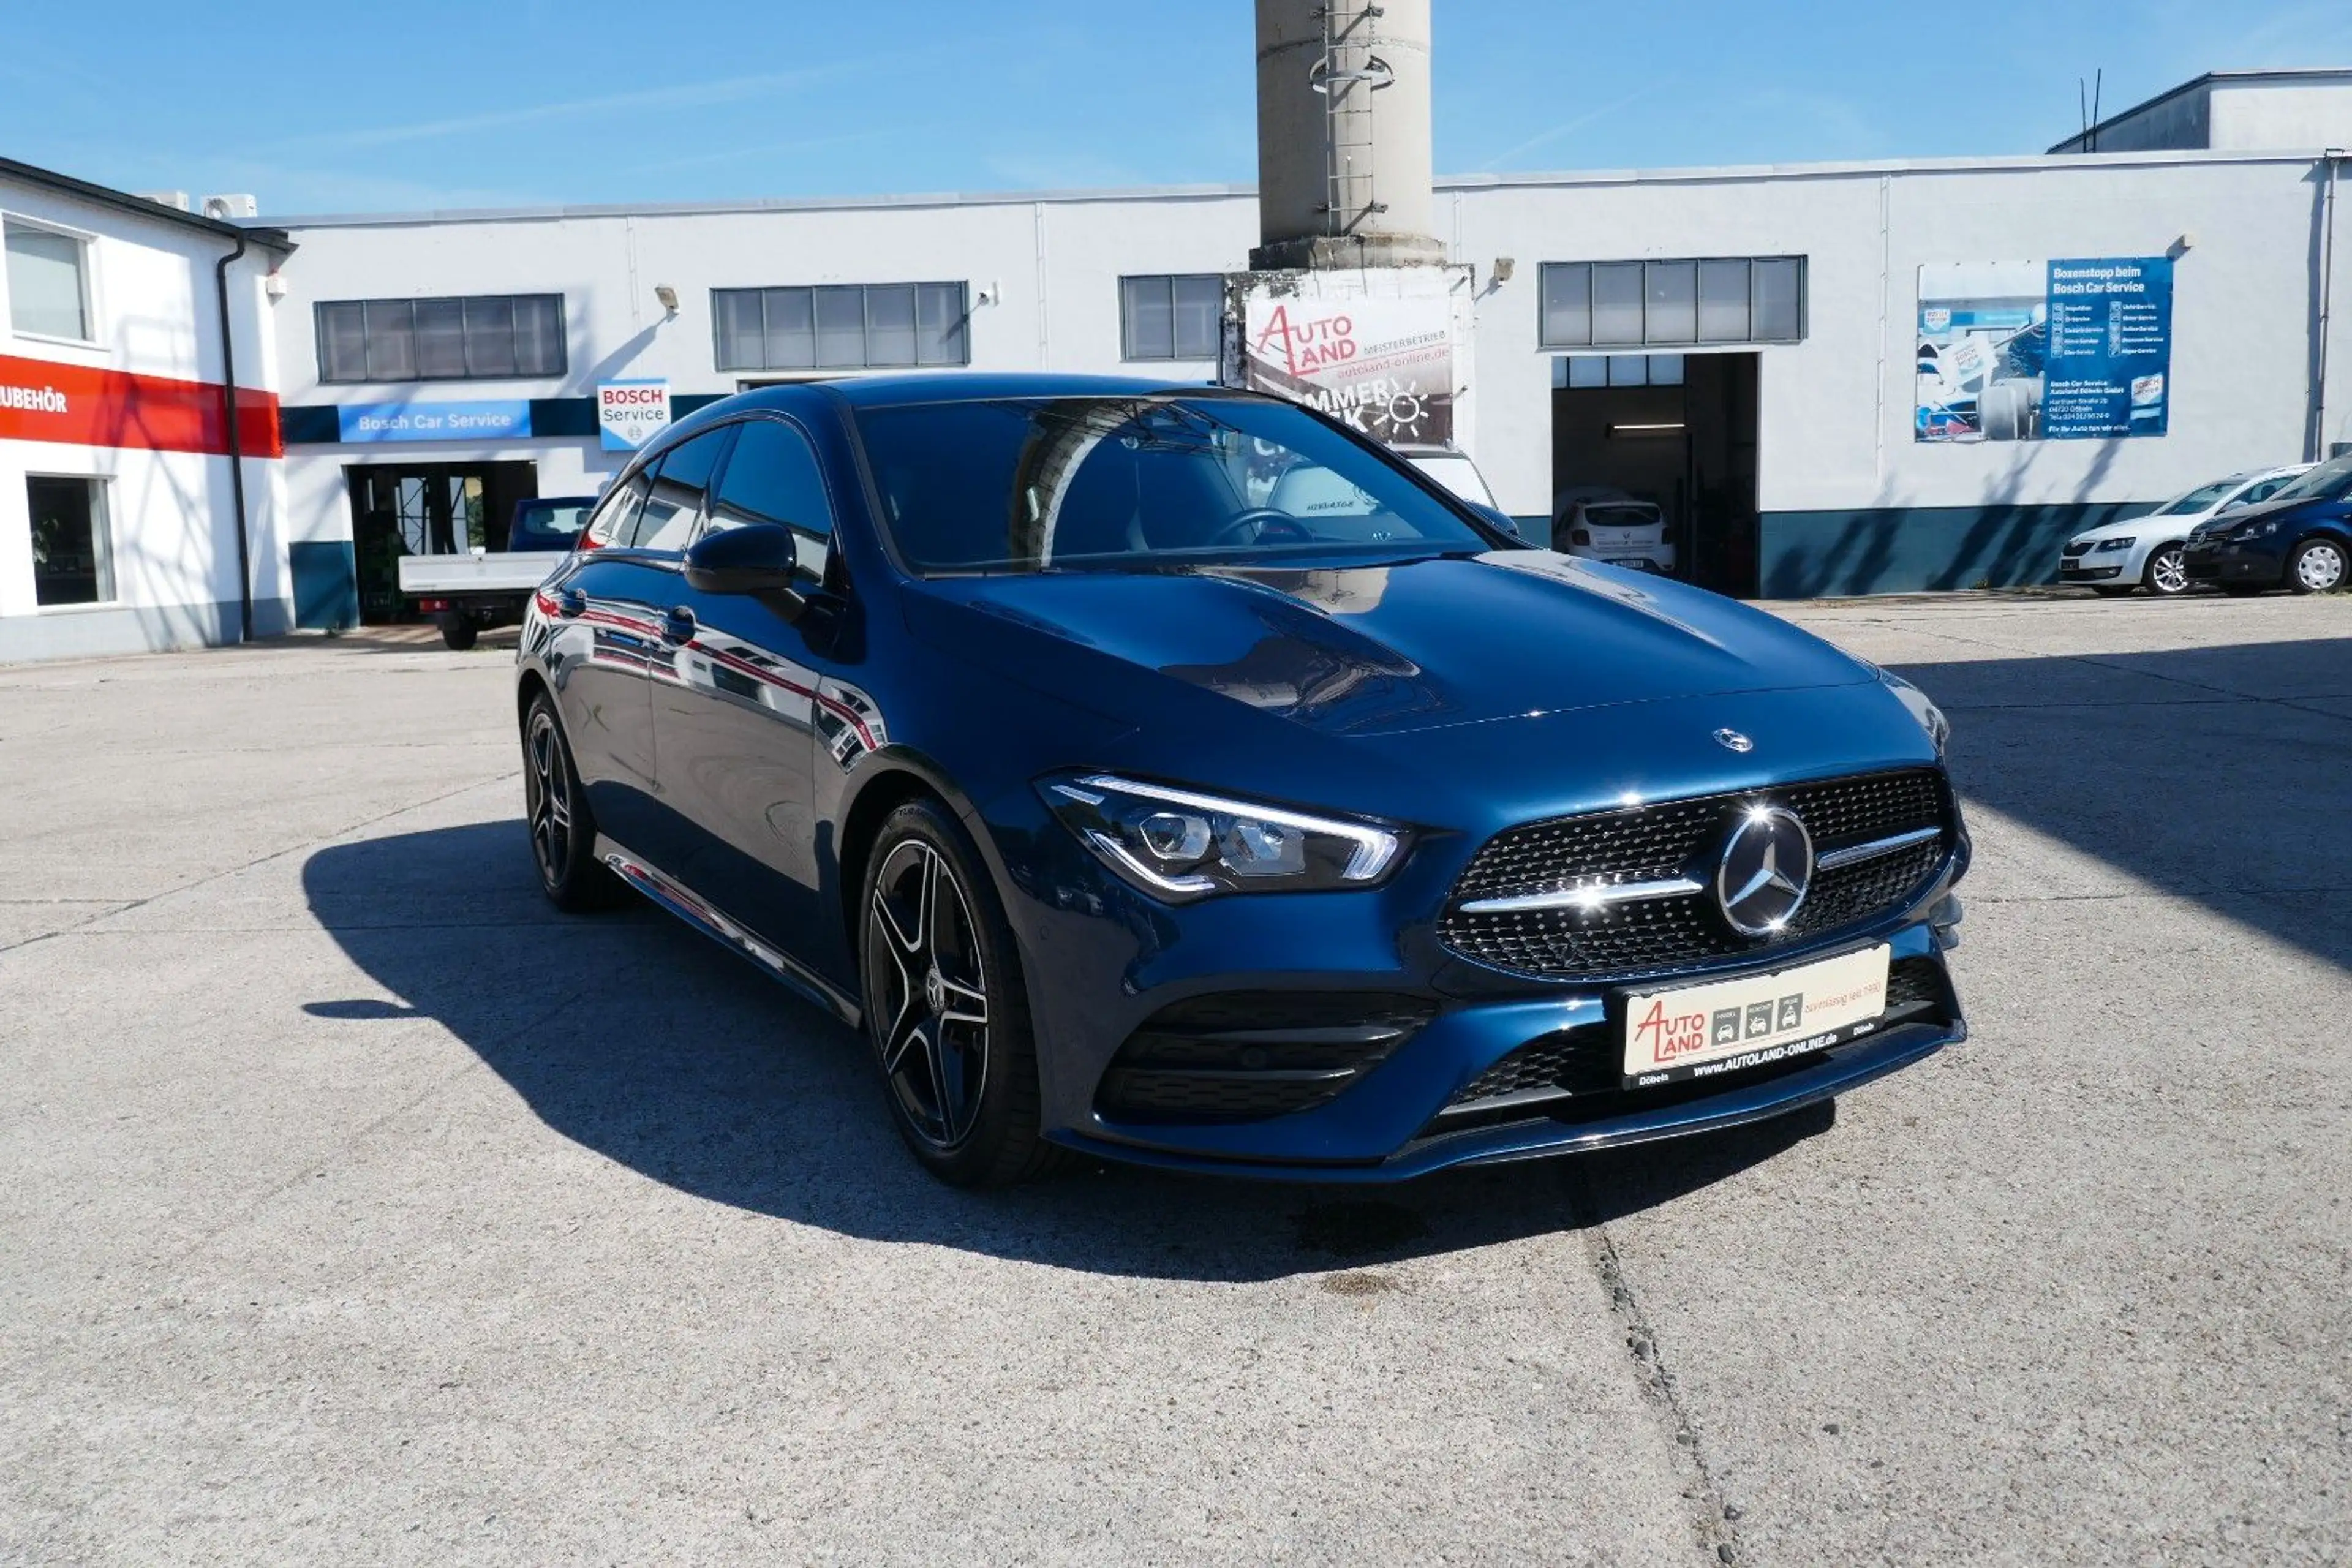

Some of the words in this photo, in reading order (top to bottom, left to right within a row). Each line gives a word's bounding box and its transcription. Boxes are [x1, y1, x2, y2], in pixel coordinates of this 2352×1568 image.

[2053, 268, 2113, 280] Boxenstopp
[2116, 266, 2141, 277] beim
[2053, 282, 2084, 294] Bosch
[2086, 282, 2104, 293] Car
[2106, 281, 2144, 292] Service
[1257, 305, 1352, 353] AUTO
[1364, 330, 1446, 355] MEISTERBETRIEB
[1287, 340, 1356, 377] LAND
[0, 385, 68, 413] UBEHÖR
[603, 389, 663, 404] BOSCH
[1305, 379, 1390, 412] MMER
[358, 415, 409, 431] Bosch
[413, 414, 443, 429] Car
[448, 412, 513, 428] Service
[603, 407, 664, 422] Service
[1635, 1000, 1705, 1042] AUTO
[1694, 1033, 1838, 1077] www.AUTOLAND-ONLINE.de
[1638, 1072, 1670, 1086] Döbeln
